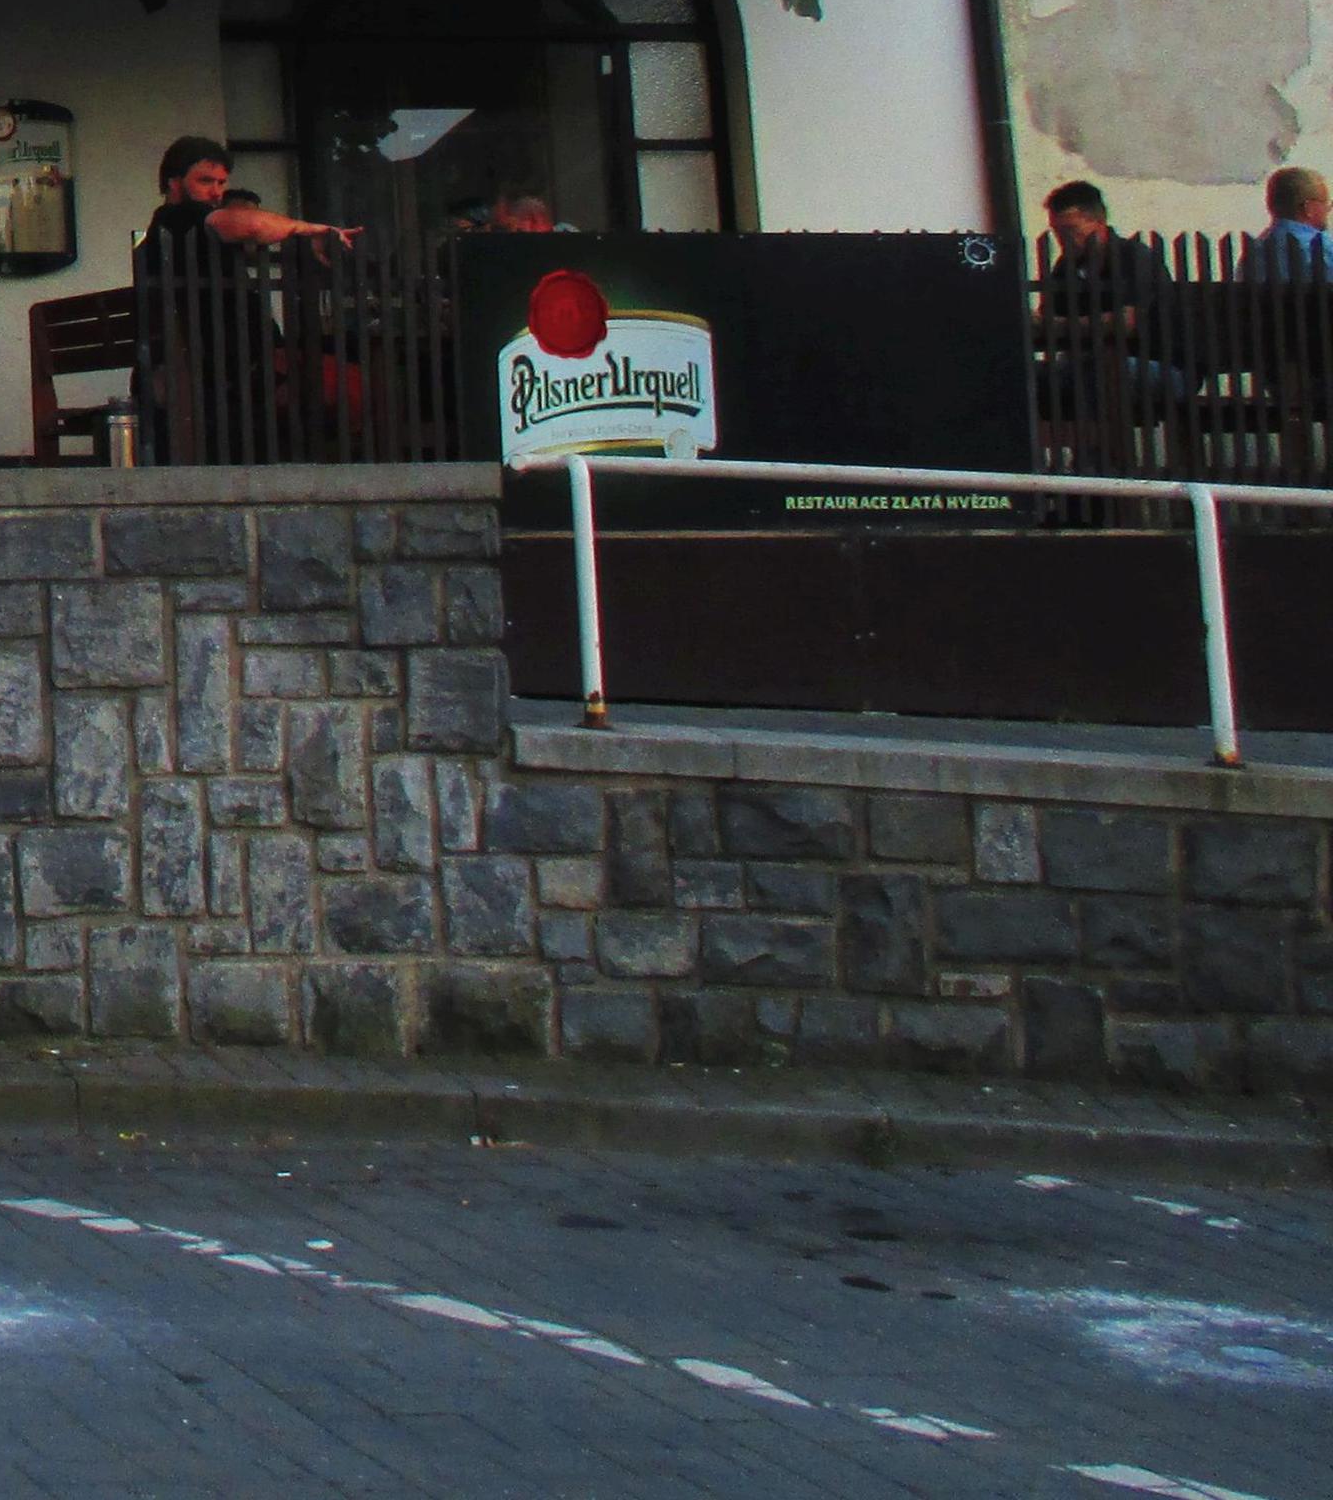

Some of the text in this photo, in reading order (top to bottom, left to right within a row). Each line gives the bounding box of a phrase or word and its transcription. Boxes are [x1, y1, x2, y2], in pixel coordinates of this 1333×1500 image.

[511, 351, 699, 434] Pilsner Urquell
[785, 493, 1012, 509] RESTAURACE ZLATÁ HVĚZDA
